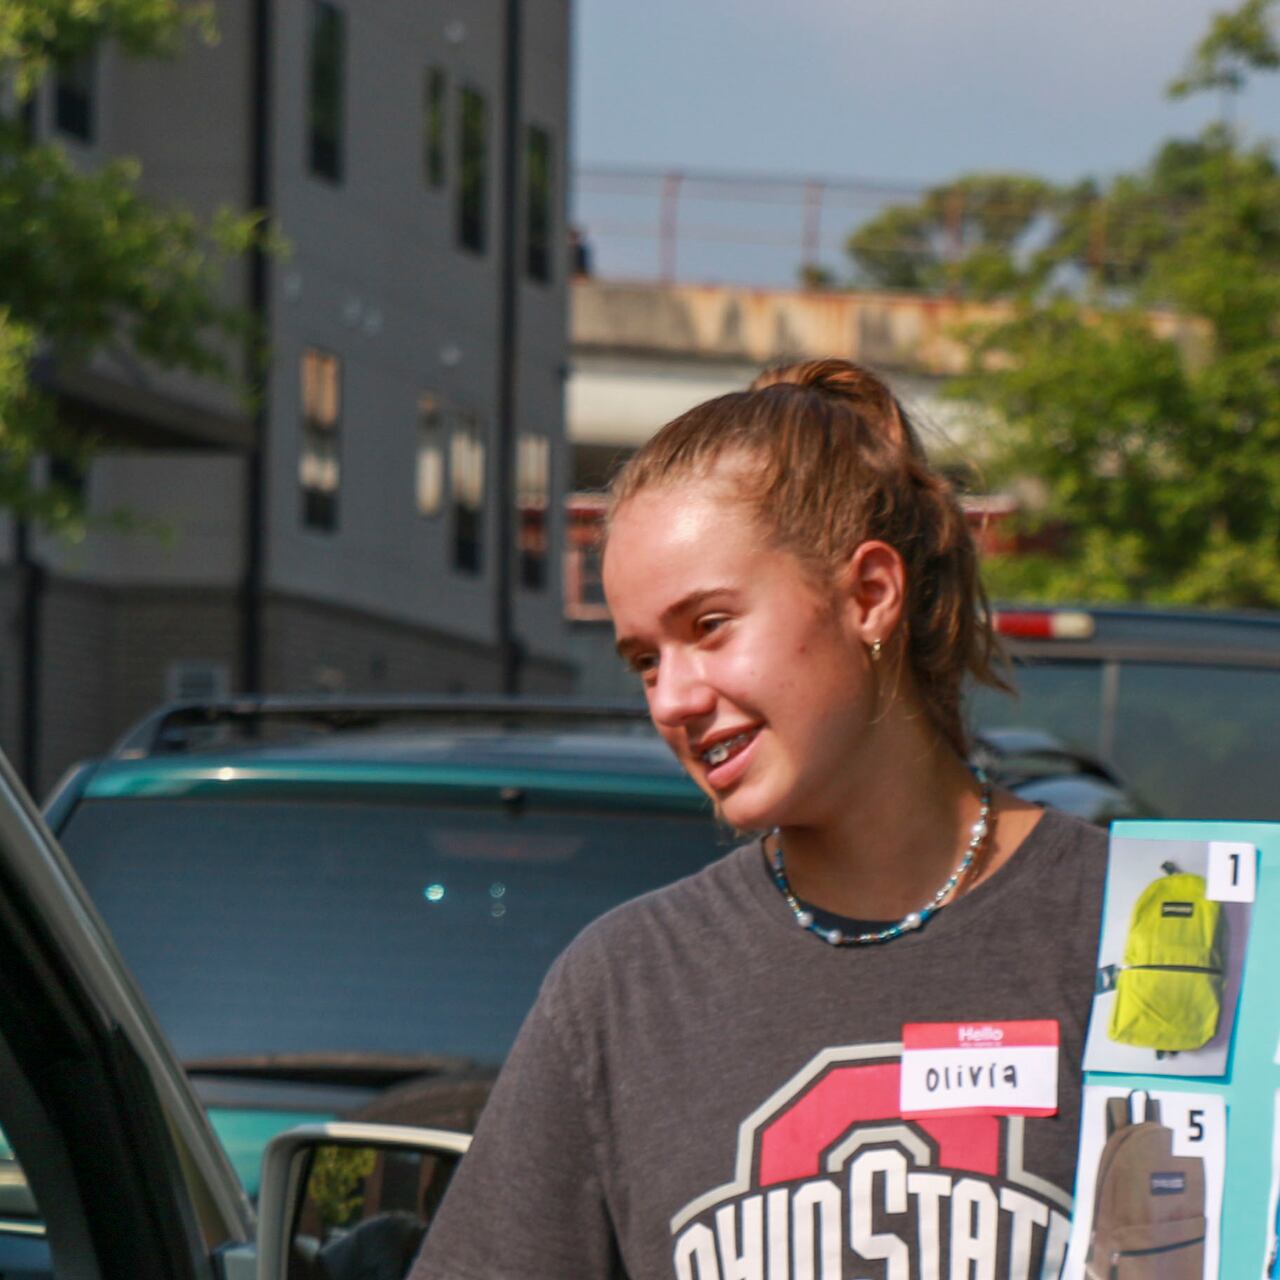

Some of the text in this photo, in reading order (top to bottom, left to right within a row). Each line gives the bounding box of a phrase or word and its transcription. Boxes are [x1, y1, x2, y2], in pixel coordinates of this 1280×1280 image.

[1228, 853, 1240, 887] 1
[959, 1026, 1004, 1042] Hello
[926, 1063, 1018, 1093] Olivia
[1188, 1109, 1204, 1142] 5
